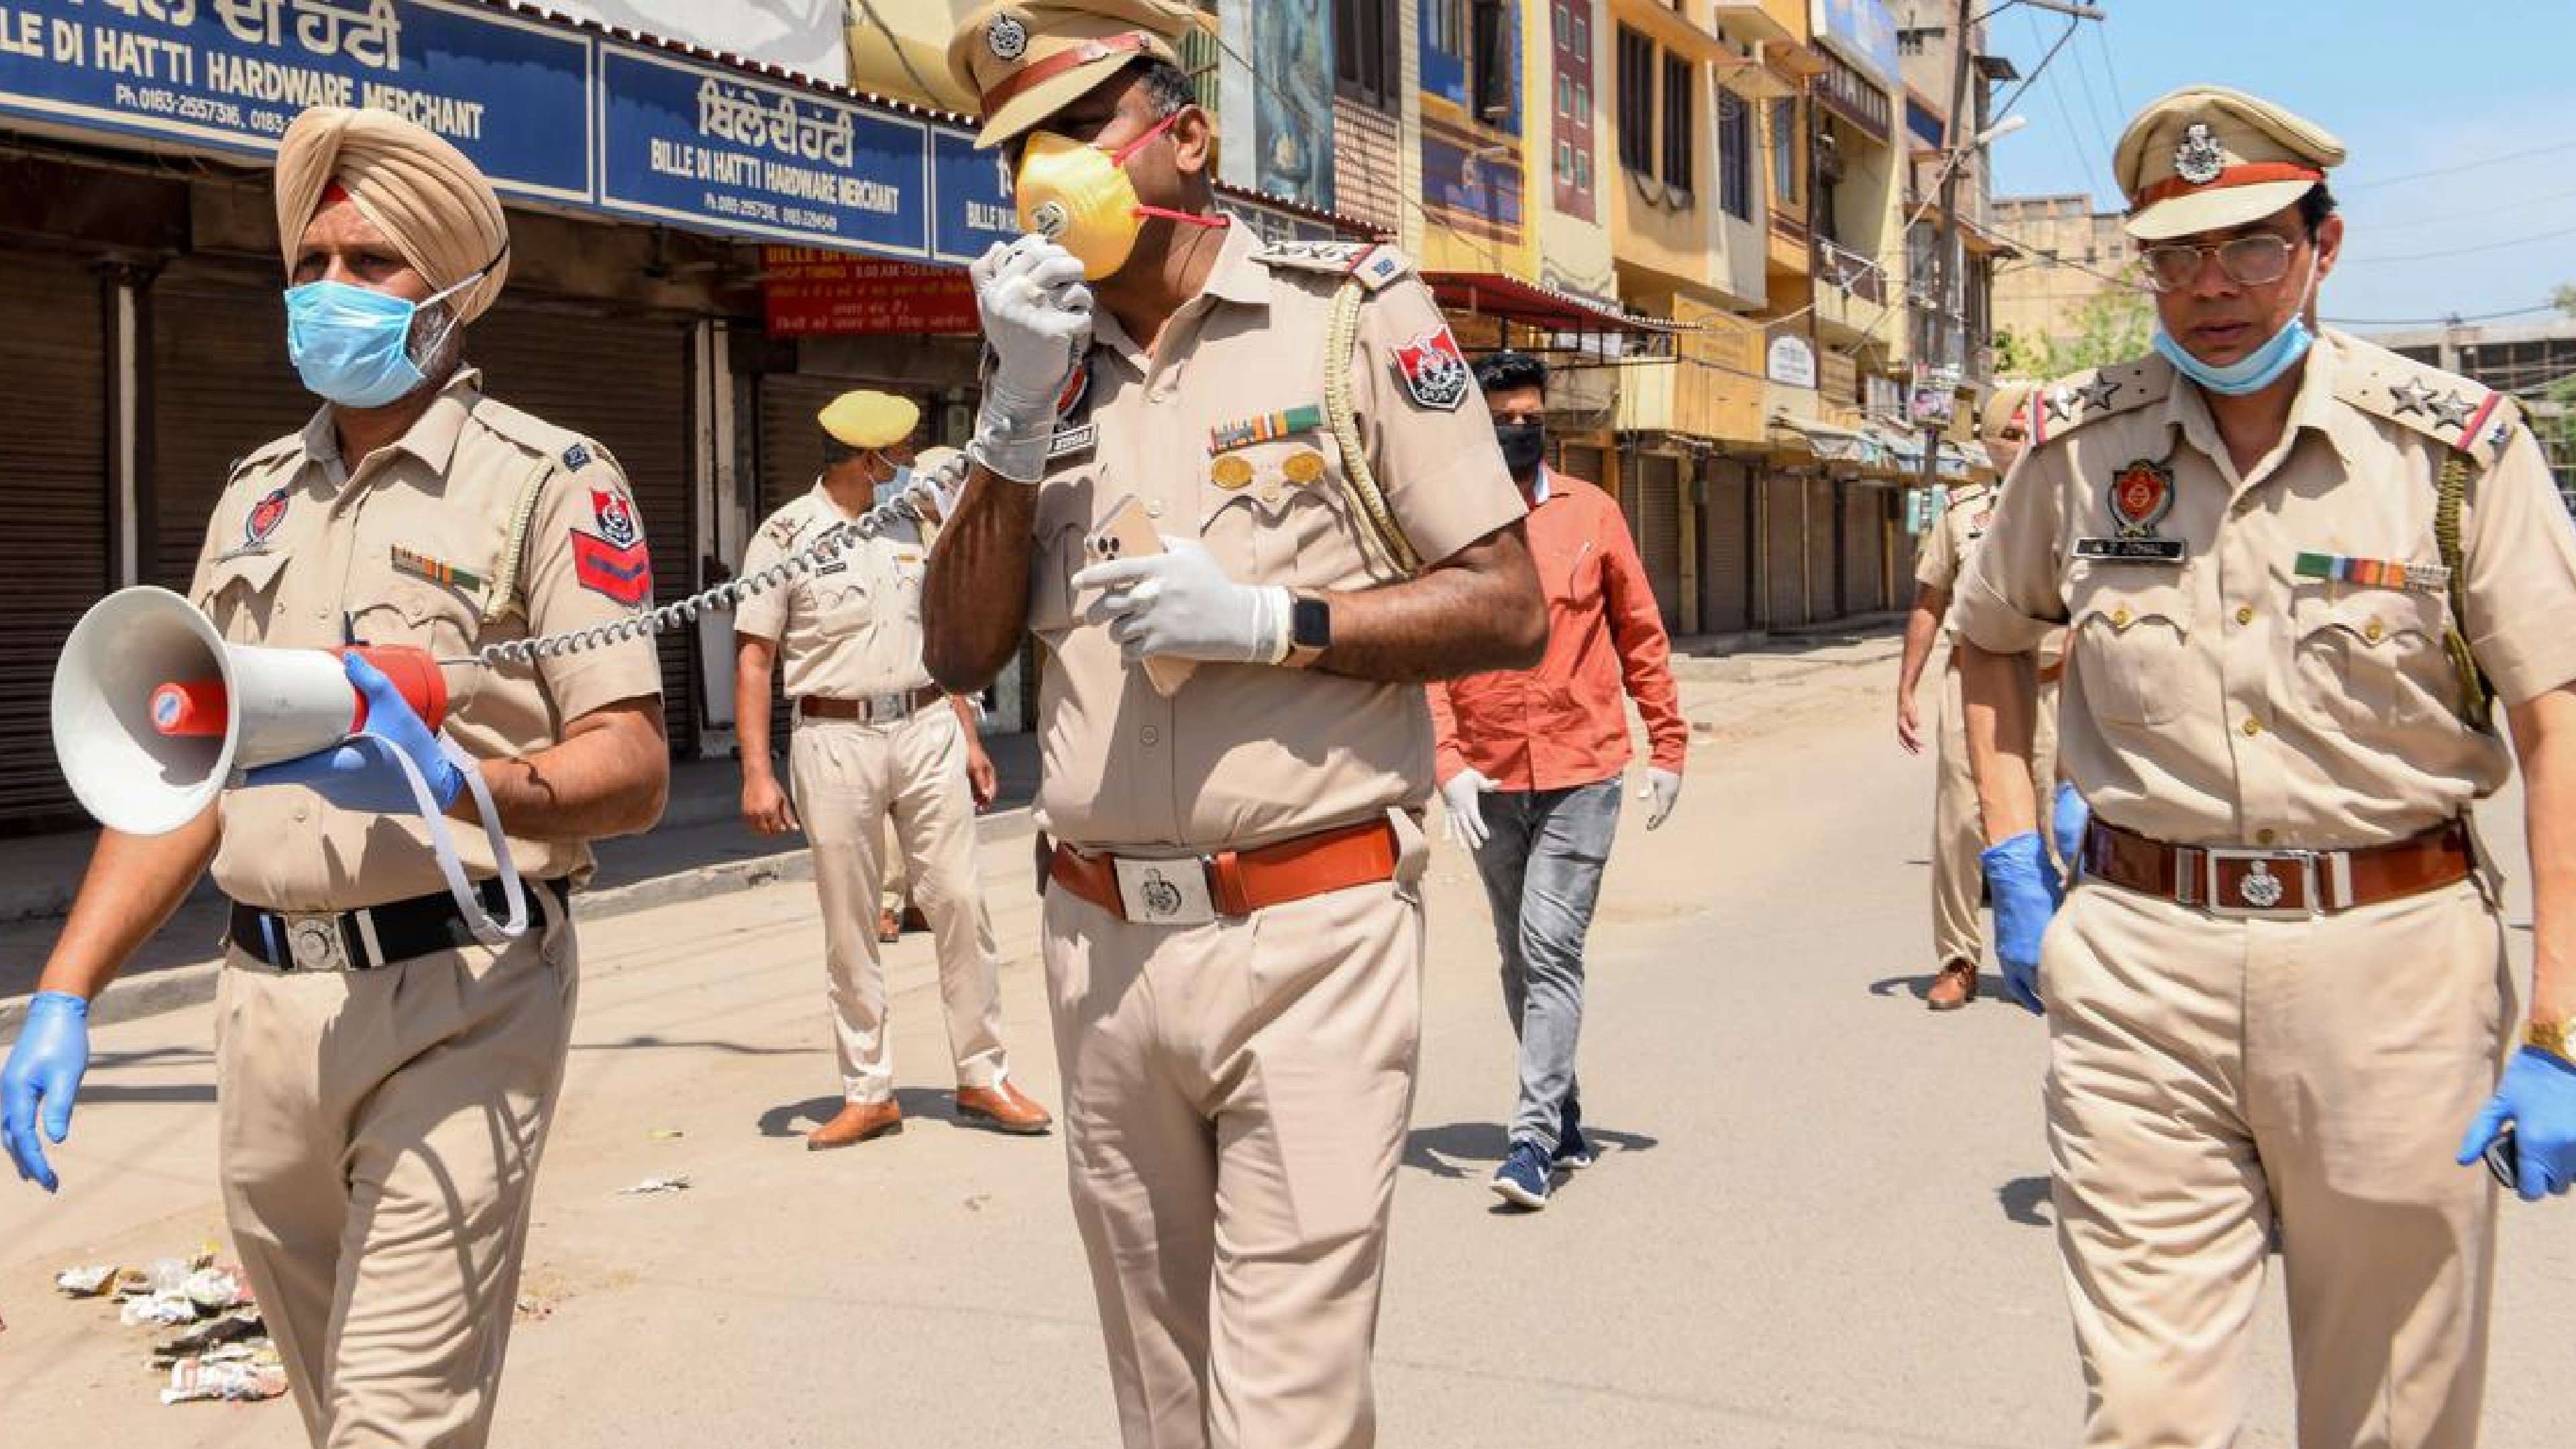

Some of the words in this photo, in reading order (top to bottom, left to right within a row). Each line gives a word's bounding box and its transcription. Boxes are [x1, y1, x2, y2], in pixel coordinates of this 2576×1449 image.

[52, 18, 84, 66] DI
[93, 25, 193, 86] HATTI
[206, 50, 354, 109] HARDWARE
[362, 80, 485, 140] MERCHANT
[651, 138, 694, 178] BILLE
[696, 147, 712, 180] DI
[713, 152, 761, 189] HATTI
[765, 161, 837, 205] HARDWARE
[838, 175, 900, 215] MERCHANT
